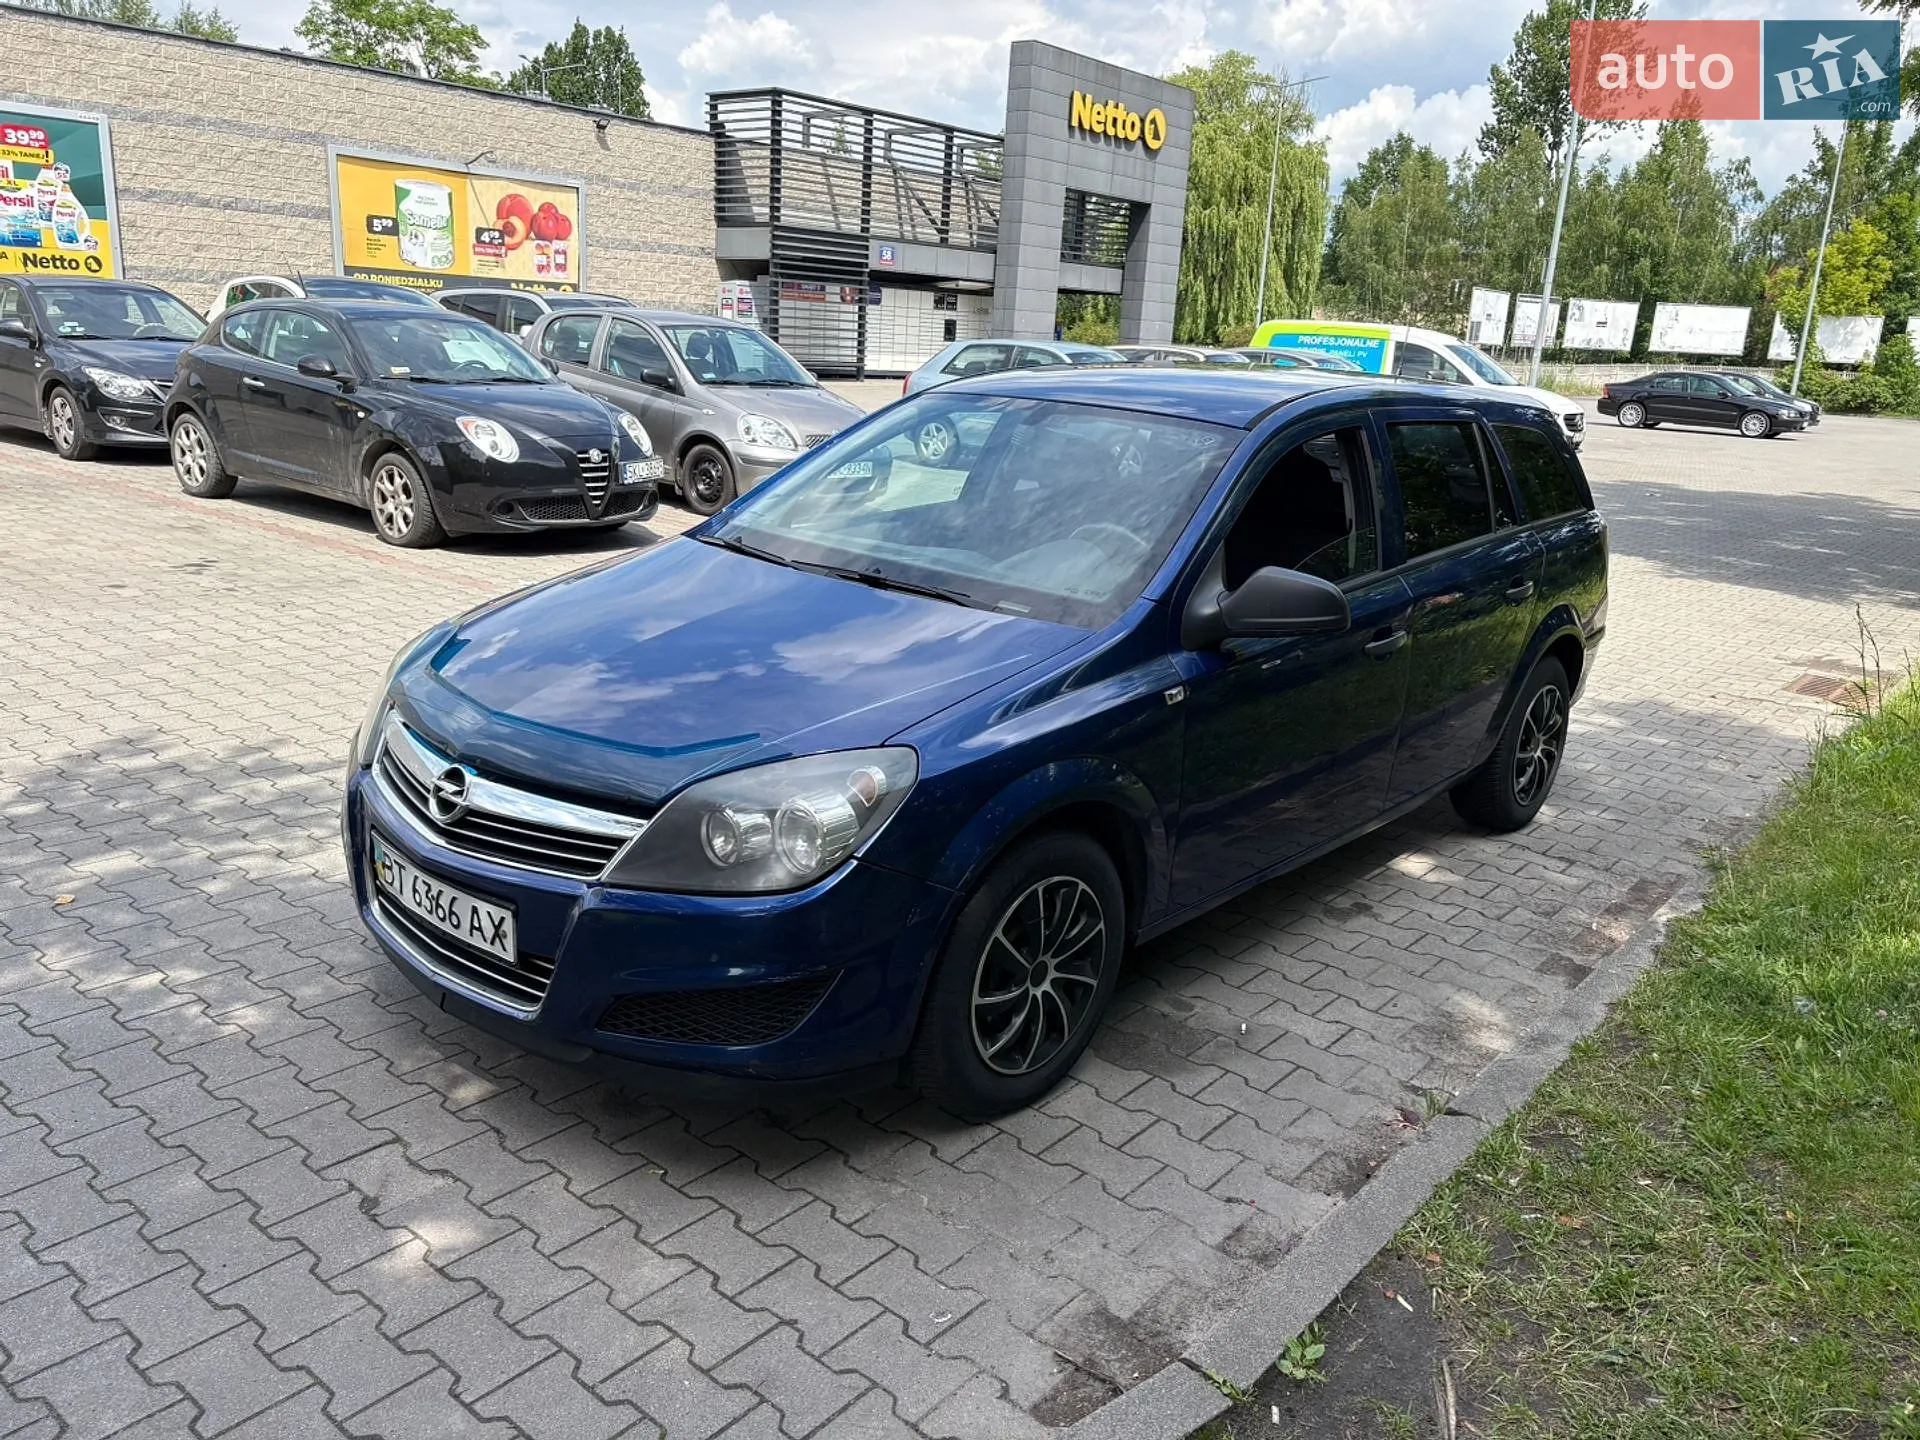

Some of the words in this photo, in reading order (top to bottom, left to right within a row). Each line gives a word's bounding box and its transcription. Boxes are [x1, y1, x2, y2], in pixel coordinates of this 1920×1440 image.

[1071, 90, 1141, 141] Netto
[38, 188, 57, 196] Persil
[22, 252, 80, 271] Netto
[1297, 335, 1380, 348] PROFESJONALNE
[383, 852, 407, 897] BT
[412, 875, 461, 930] 6366
[469, 904, 508, 953] AX
